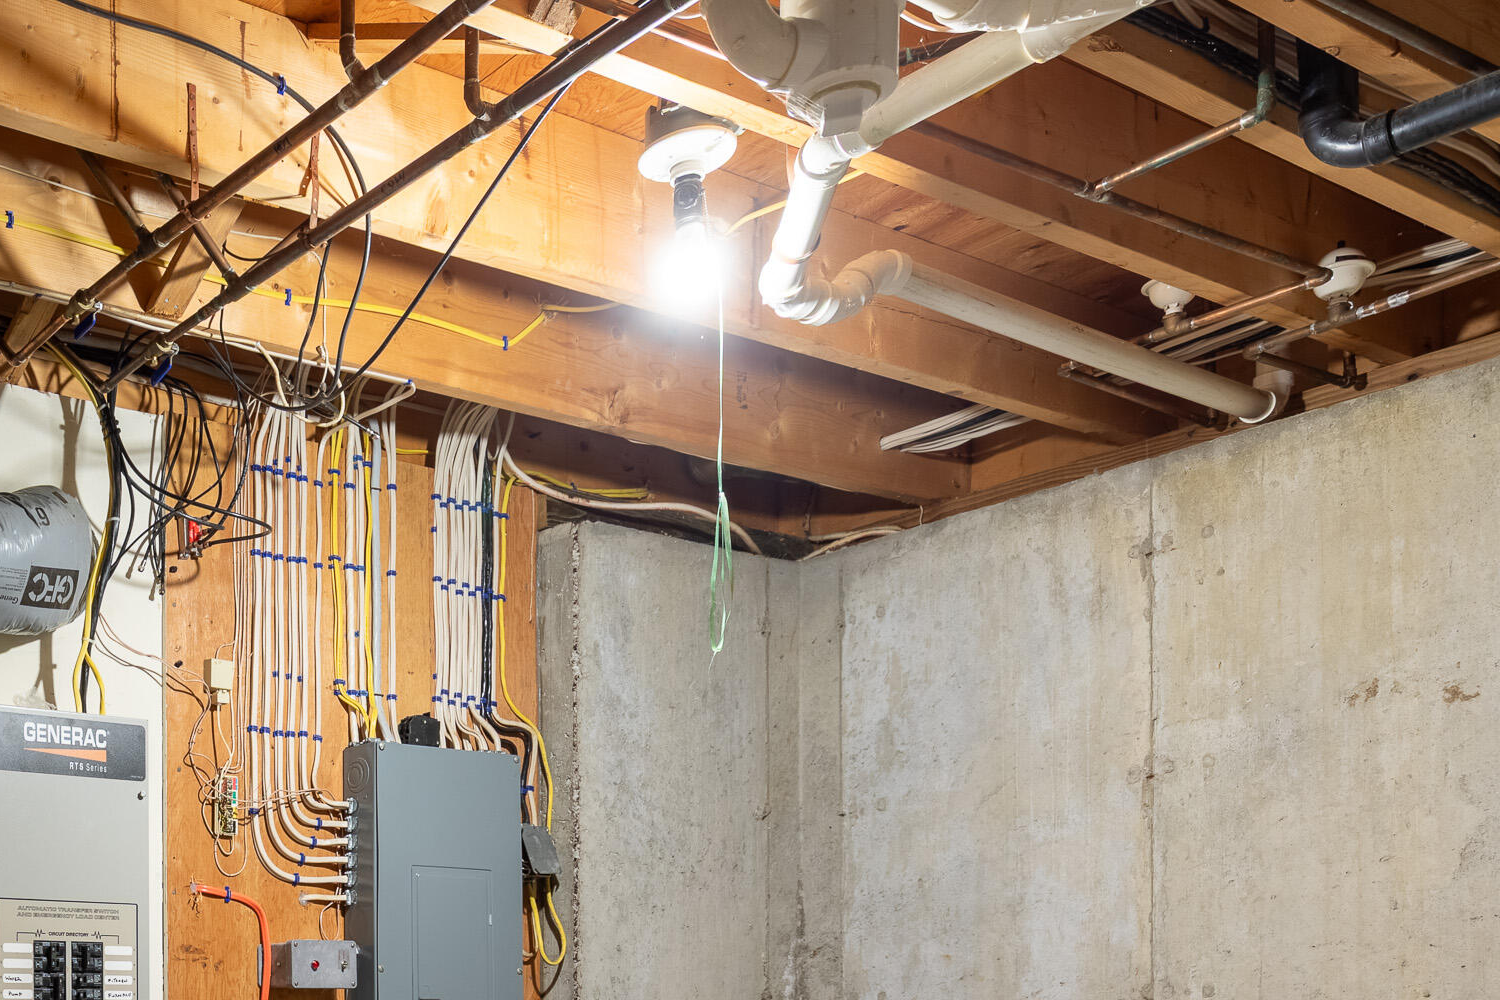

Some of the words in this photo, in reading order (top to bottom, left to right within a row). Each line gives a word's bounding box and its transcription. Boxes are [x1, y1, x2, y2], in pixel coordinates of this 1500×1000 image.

[23, 720, 107, 748] GENERAC
[69, 761, 84, 771] RTS
[85, 762, 107, 773] Series
